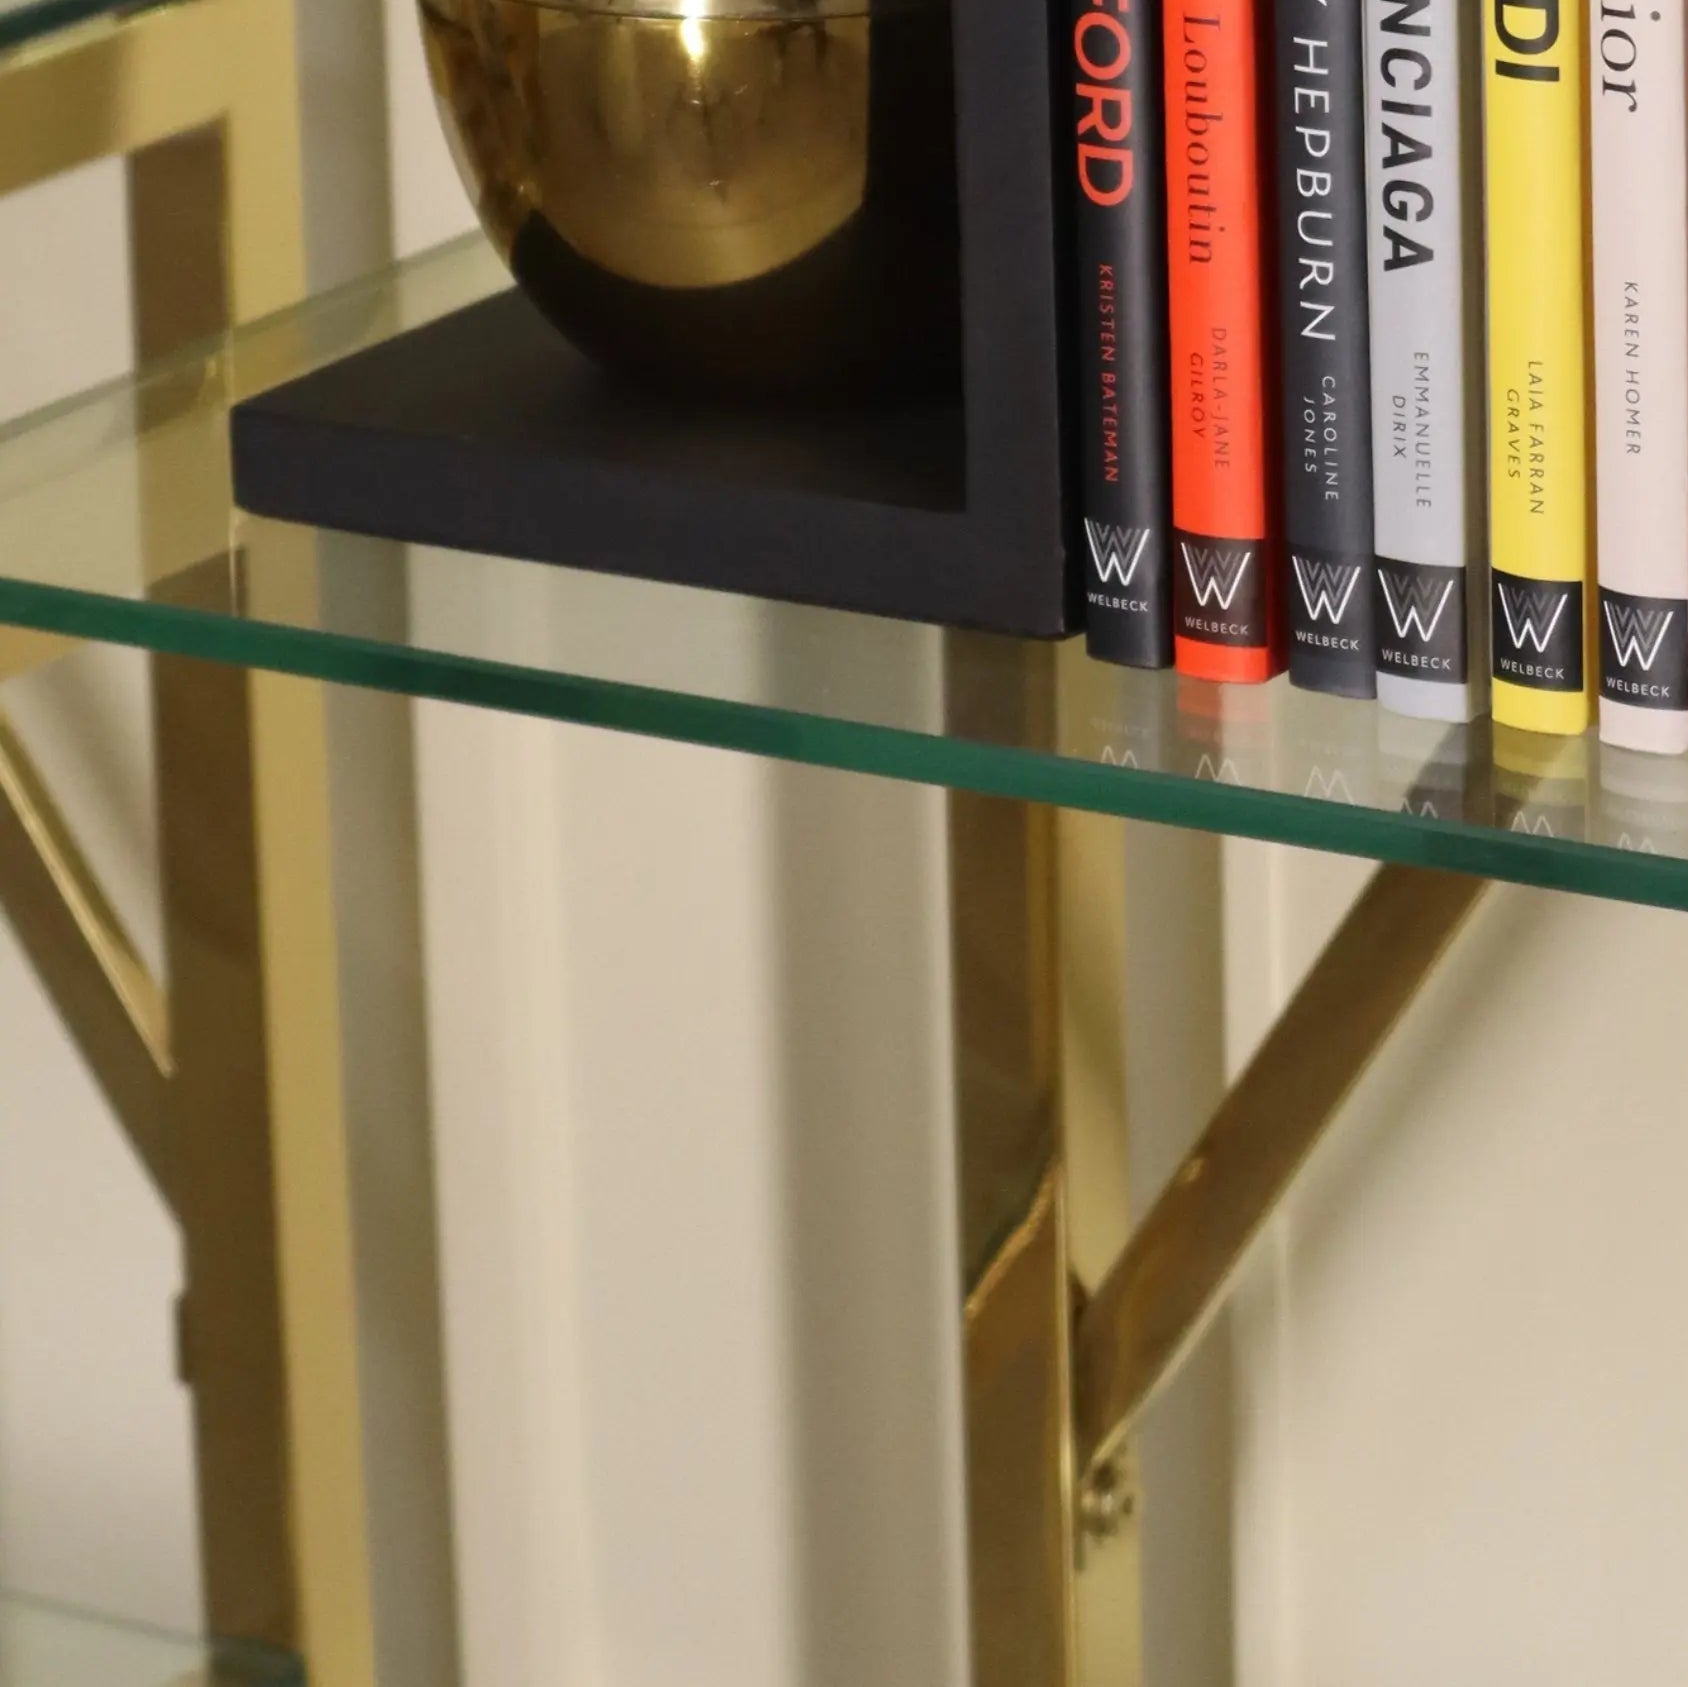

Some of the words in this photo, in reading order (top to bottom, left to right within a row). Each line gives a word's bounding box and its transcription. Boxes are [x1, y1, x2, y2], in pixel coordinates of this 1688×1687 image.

[1182, 13, 1226, 265] Louboutin
[1293, 37, 1336, 341] HEPBURN
[1099, 263, 1116, 361] KRISTEN
[1624, 281, 1639, 357] KAREN
[1102, 372, 1119, 482] BATEMAN
[1190, 352, 1204, 437] GILROY
[1212, 328, 1229, 469] DARLA-JANE
[1392, 395, 1407, 458] DIRIX
[1528, 360, 1544, 411] LAIA
[1625, 370, 1641, 454] HOMER
[1303, 397, 1316, 473] JONES
[1322, 376, 1339, 500] CAROLINE
[1414, 352, 1432, 508] EMMANUELLE
[1506, 388, 1520, 479] GRAVES
[1529, 423, 1544, 514] FARRAN
[1087, 592, 1149, 612] WELBECK
[1185, 616, 1249, 636] WELBECK
[1296, 631, 1359, 651] WELBECK
[1382, 648, 1450, 670] WELBECK
[1500, 657, 1564, 680] WELBECK
[1606, 676, 1670, 699] WELBECK
